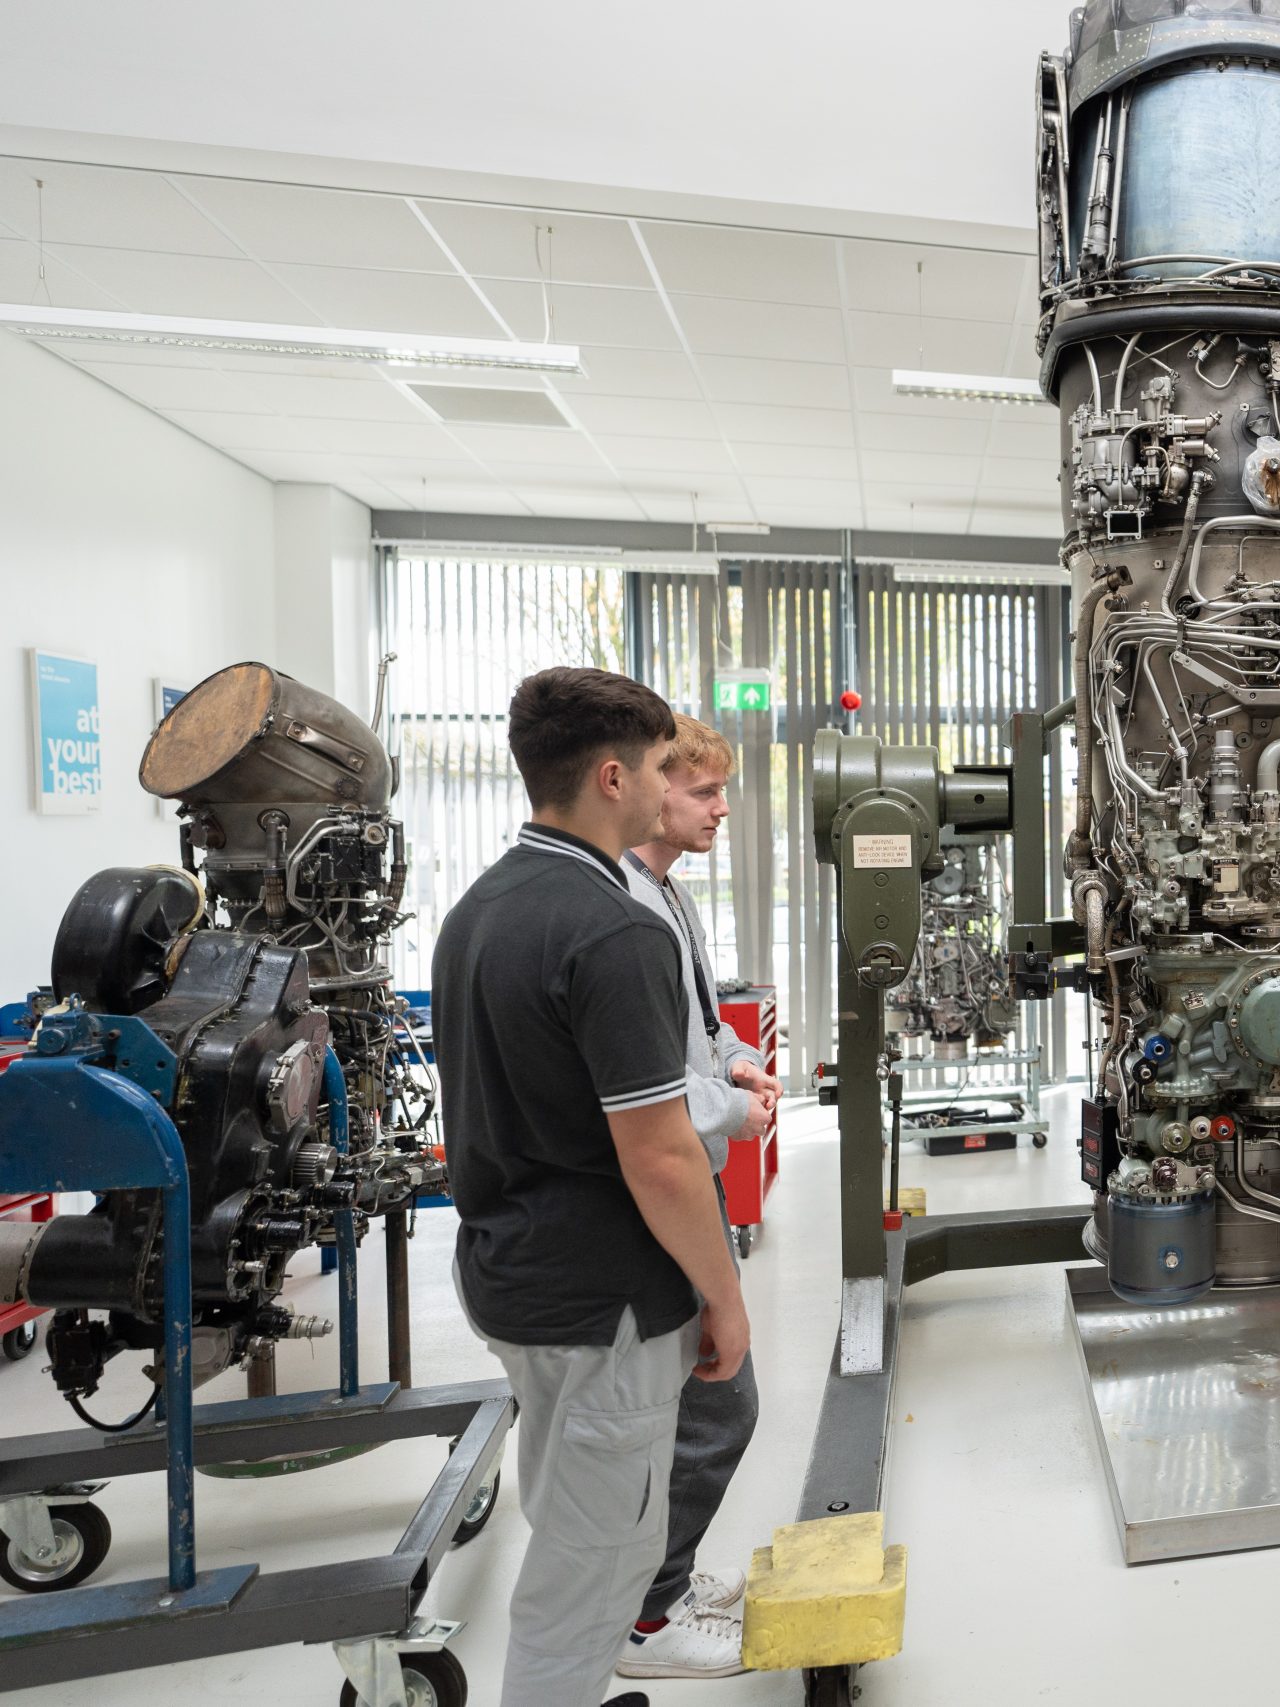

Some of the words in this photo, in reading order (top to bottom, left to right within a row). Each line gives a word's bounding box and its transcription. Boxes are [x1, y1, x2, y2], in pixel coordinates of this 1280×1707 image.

[76, 705, 100, 735] at
[47, 737, 101, 771] your
[53, 766, 102, 794] best
